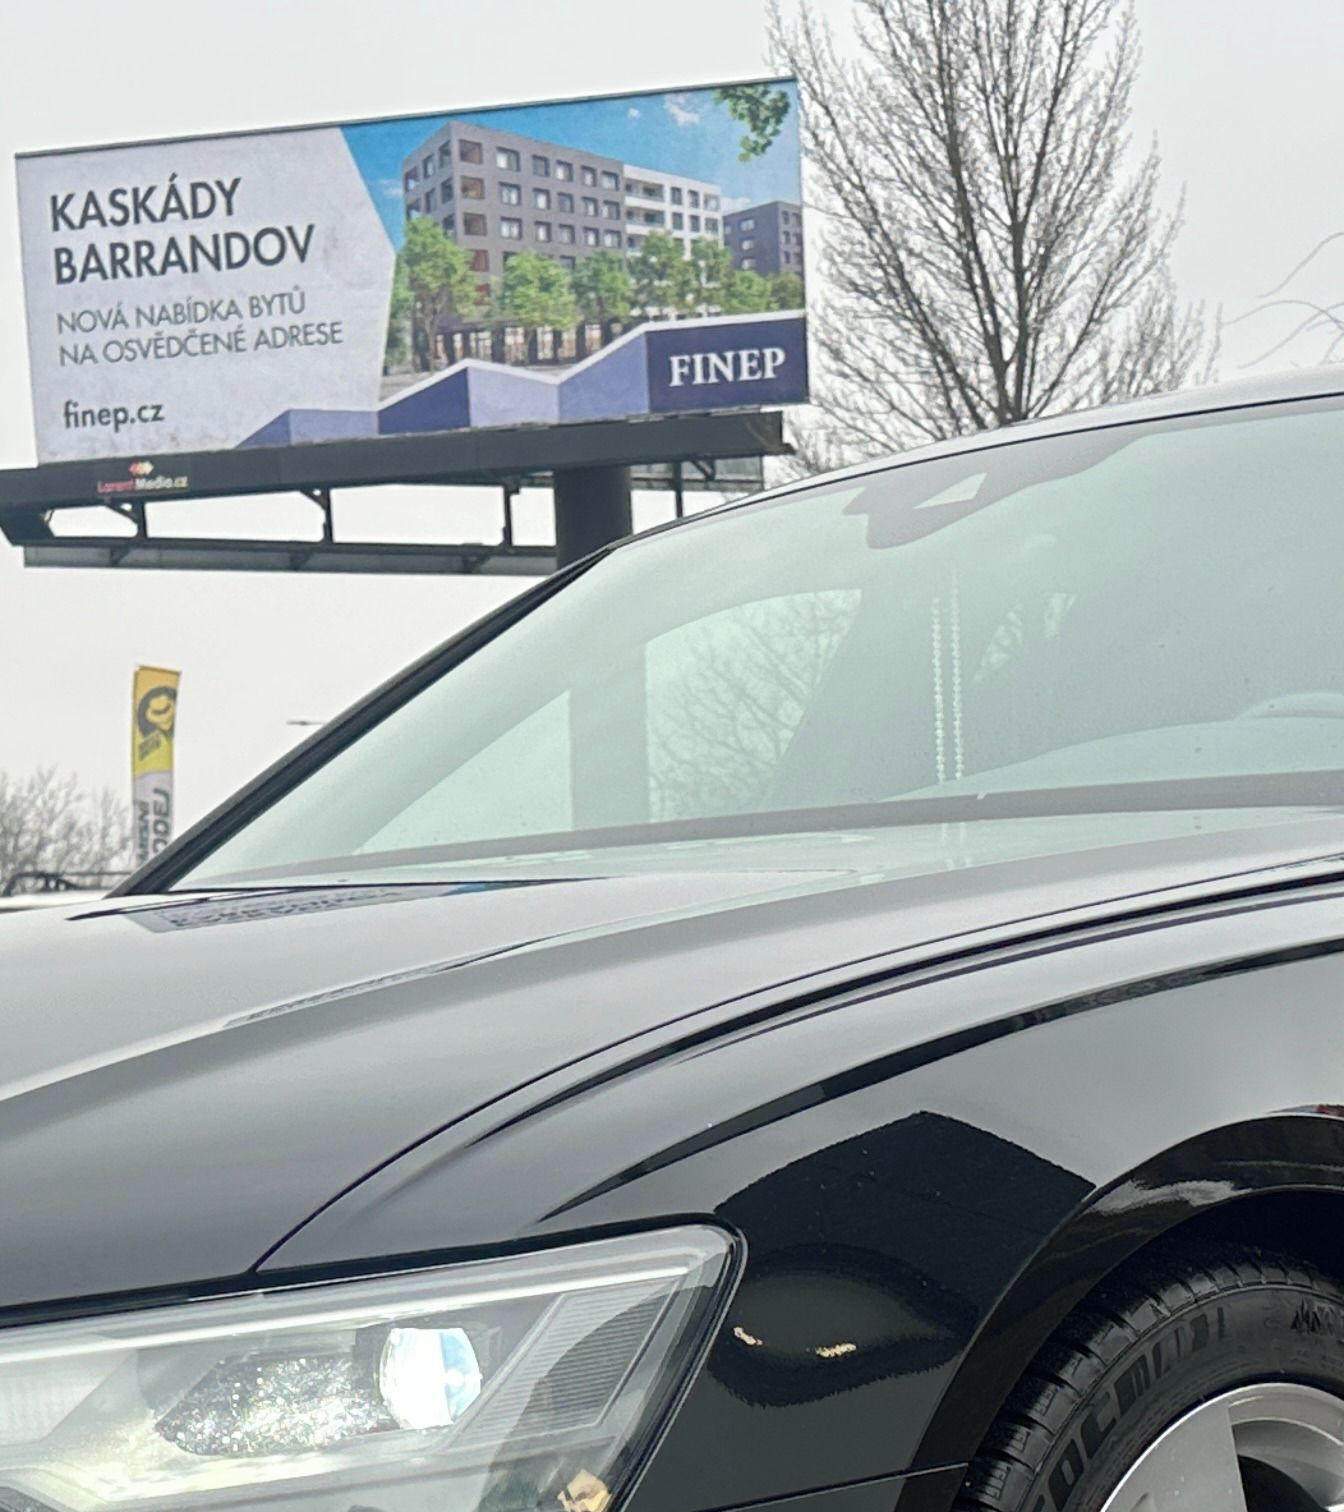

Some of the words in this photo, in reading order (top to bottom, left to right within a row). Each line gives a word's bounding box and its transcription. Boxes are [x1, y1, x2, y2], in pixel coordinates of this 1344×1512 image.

[50, 172, 242, 232] KASKÁDY
[54, 224, 315, 285] BARRANDOV
[57, 303, 129, 335] NOVÁ
[135, 296, 243, 329] NABÍDKA
[248, 284, 307, 319] BYTŮ
[59, 344, 98, 367] NA
[102, 324, 247, 364] OSVĚDČENÉ
[253, 321, 344, 352] ADRESE
[669, 346, 786, 387] FINEP
[63, 400, 166, 433] finep.cz
